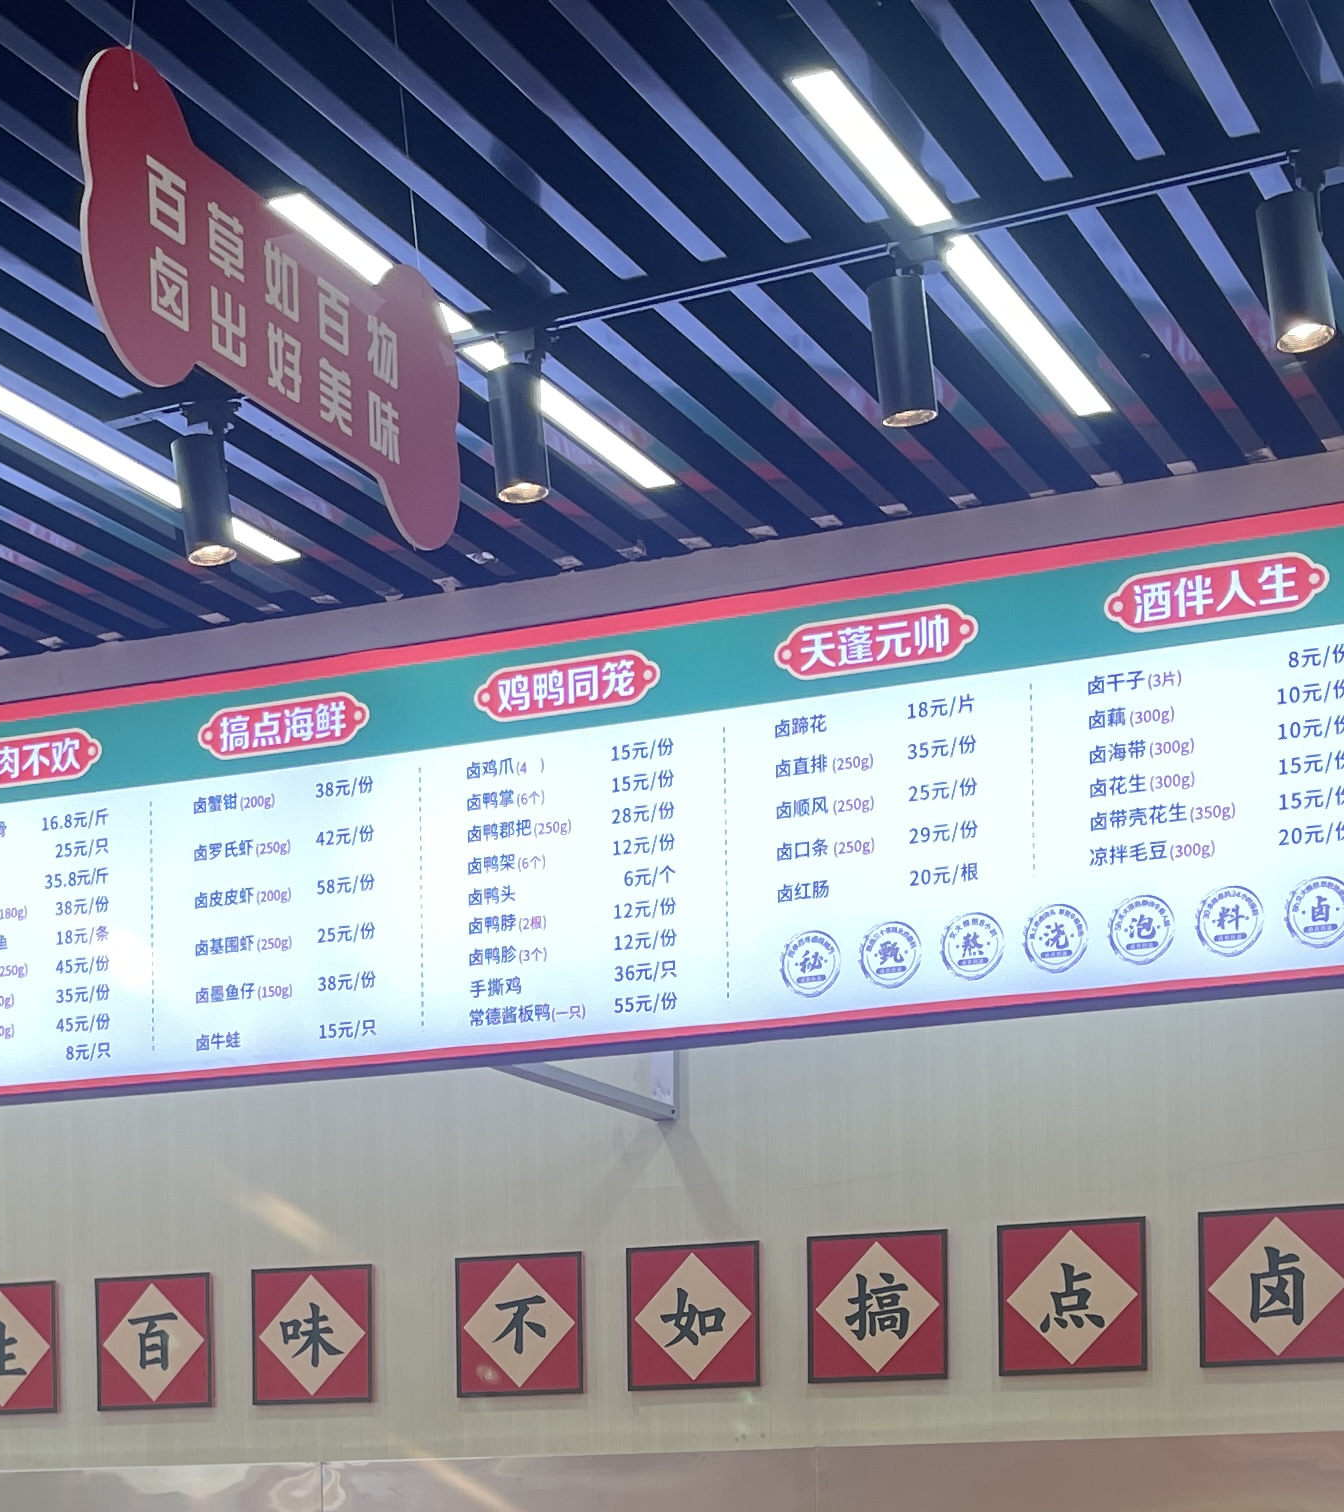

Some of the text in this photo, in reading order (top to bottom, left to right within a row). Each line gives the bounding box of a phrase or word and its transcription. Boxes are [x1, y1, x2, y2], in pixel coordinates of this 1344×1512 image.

[145, 154, 399, 390] 百草如百物
[150, 246, 401, 465] 卤出好美味
[1132, 562, 1300, 625] 酒伴人生
[800, 612, 950, 673] 天蓬元帅
[497, 659, 636, 714] 鸡鸭同笼
[1088, 670, 1181, 696] 卤干子(3片)
[219, 700, 346, 753] 搞点海鲜
[775, 693, 975, 739] 卤蹄花 18元/片
[1089, 706, 1174, 730] 卤藕(300g)
[611, 738, 674, 761] 15元/份
[776, 734, 976, 779] 卤直排 (250g) 35元/份
[1089, 738, 1194, 765] 卤海带(300g)
[194, 776, 374, 814] 卤蟹钳(200g) 38元/份
[467, 769, 674, 812] 卤鸭掌(6个) 15元/份
[776, 777, 977, 819] 卤顺风 (250g) 25元/份
[1090, 771, 1195, 798] 卤花生(300g)
[42, 808, 109, 831] 16.8元/斤
[468, 801, 675, 843] 卤鸭郡把(250g) 28元/份
[1091, 802, 1235, 832] 卤带壳花生(350g)
[55, 838, 109, 858] 25元/只
[194, 824, 374, 862] 卤罗氏虾(250g) 42元/份
[468, 833, 675, 875] 卤鸭架(6个) 12元/份
[777, 820, 978, 862] 卤口条 (250g) 29元/份
[1090, 840, 1215, 866] 凉拌毛豆(300g)
[45, 867, 109, 889] 35.8元/斤
[195, 873, 375, 909] 卤皮皮虾(200g) 58元/份
[468, 865, 675, 907] 卤鸭头 6元/个
[777, 862, 979, 903] 卤红肠 20元/根
[55, 896, 109, 916] 38元/份
[469, 897, 676, 935] 卤鸭脖(2根) 12元/份
[56, 926, 109, 945] 18元/条
[195, 922, 375, 957] 卤基围虾(250g) 25元/份
[469, 928, 677, 967] 卤鸭胗(3个) 12元/份
[56, 955, 109, 974] 45元/份
[470, 960, 677, 998] 手撕鸡 36元/只
[56, 984, 110, 1003] 35元/份
[196, 970, 376, 1004] 卤墨鱼仔(150g) 38元/份
[56, 1013, 110, 1033] 45元/份
[469, 992, 678, 1028] 常德酱板鸭(一只) 55元/份
[66, 1042, 111, 1062] 8元/只
[196, 1019, 377, 1052] 卤牛蛙 15元/只
